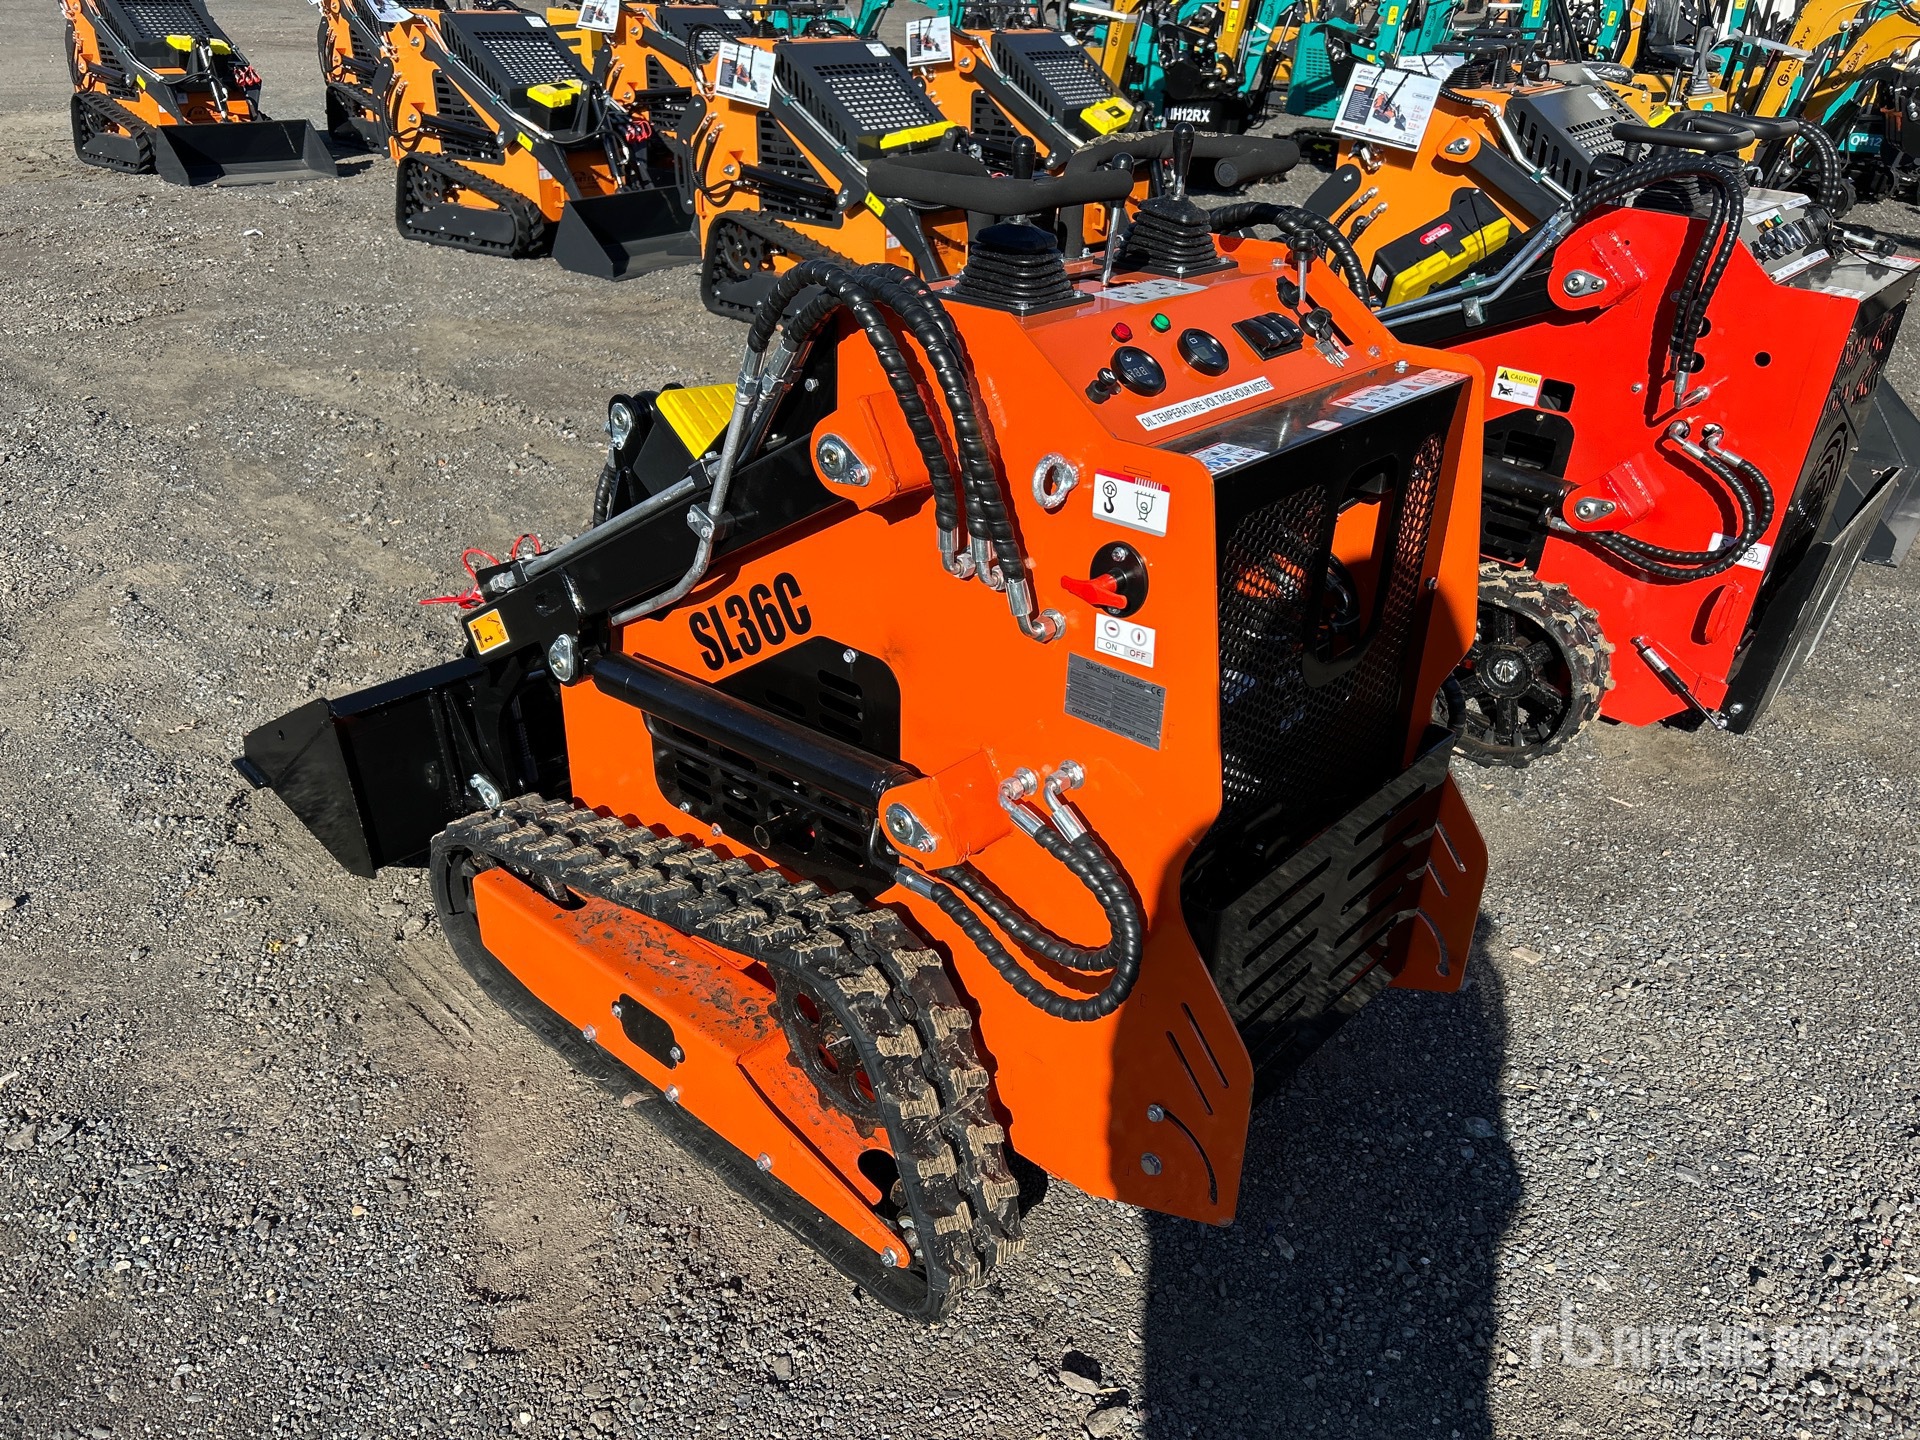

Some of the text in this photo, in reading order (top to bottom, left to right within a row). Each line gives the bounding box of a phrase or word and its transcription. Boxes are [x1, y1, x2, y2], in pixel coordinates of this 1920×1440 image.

[1510, 373, 1539, 385] CAUTION
[1141, 380, 1273, 428] OIL TEMPERATURE VOLTAGE HOUR METER
[688, 572, 812, 671] SL36C
[1105, 641, 1146, 660] ON OFF
[1085, 661, 1101, 674] Skid
[1101, 667, 1121, 680] Steer
[1121, 676, 1147, 691] Loader
[1071, 707, 1151, 743] contact24h@foxmail.com
